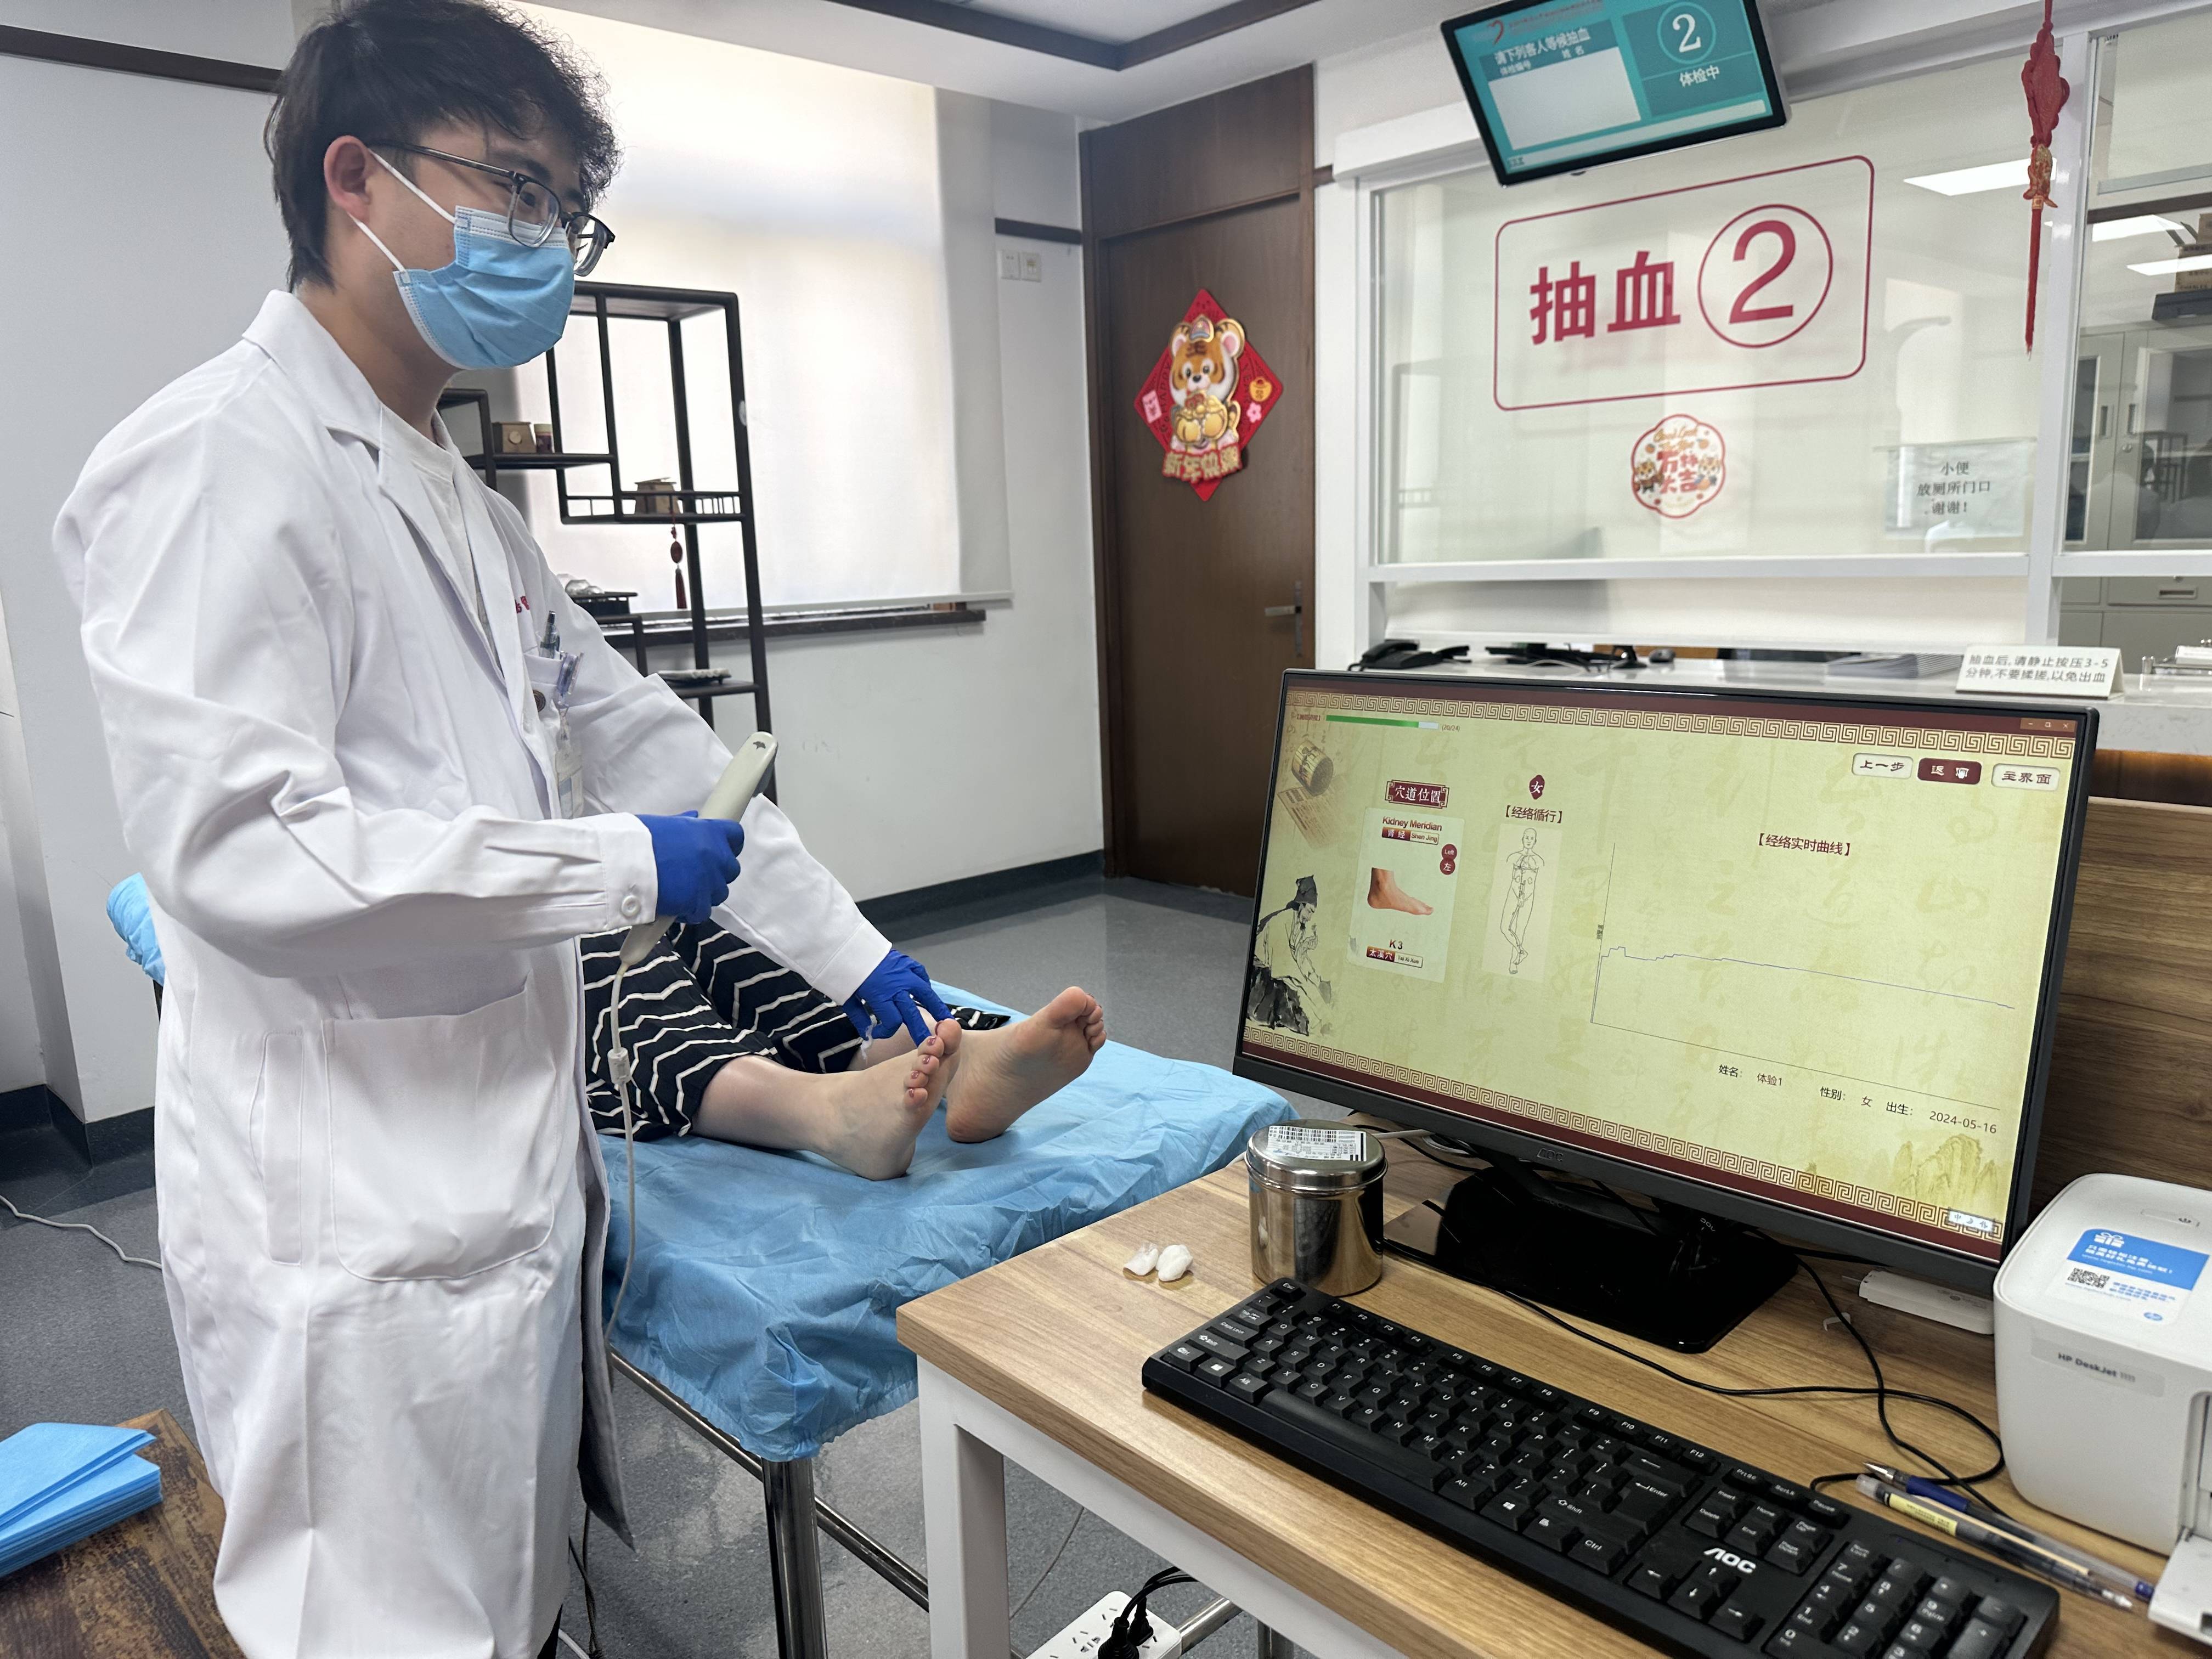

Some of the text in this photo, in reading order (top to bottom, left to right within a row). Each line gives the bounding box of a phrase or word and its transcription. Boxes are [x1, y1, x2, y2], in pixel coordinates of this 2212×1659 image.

[1672, 14, 1701, 53] 2
[1679, 65, 1720, 87] 体检中
[1530, 220, 1796, 346] 抽血 2
[1940, 461, 1970, 476] 小便
[1916, 481, 1990, 496] 放厕所门口
[1859, 760, 1905, 772] 上一步
[2001, 771, 2052, 785] 主界面
[1530, 781, 1543, 793] 女
[1394, 785, 1441, 803] 穴道位置
[1382, 816, 1442, 831] Kidney Meridian
[1426, 835, 1437, 843] Jing
[1443, 862, 1452, 872] 左
[1369, 949, 1392, 961] 太溪穴
[1756, 1073, 1783, 1086] 体验1
[1861, 1096, 1873, 1107] 女
[1929, 1111, 1997, 1134] 2024-05-16
[1177, 1347, 1190, 1355] Ctrl
[2058, 1352, 2072, 1361] HP
[2075, 1358, 2117, 1378] DeskJet
[1690, 1449, 1704, 1458] F12
[1455, 1479, 1468, 1487] Alt
[1649, 1487, 1668, 1497] Enter
[1567, 1504, 1582, 1514] Shift
[1742, 1526, 1756, 1536] End
[1585, 1539, 1602, 1550] Ctrl
[1703, 1547, 1756, 1573] AOC
[1820, 1585, 1830, 1593] 4
[1865, 1603, 1875, 1613] 5
[1927, 1600, 1938, 1610] 9
[1785, 1629, 1796, 1639] 0
[1848, 1626, 1859, 1637] 2
[1911, 1623, 1922, 1634] 6
